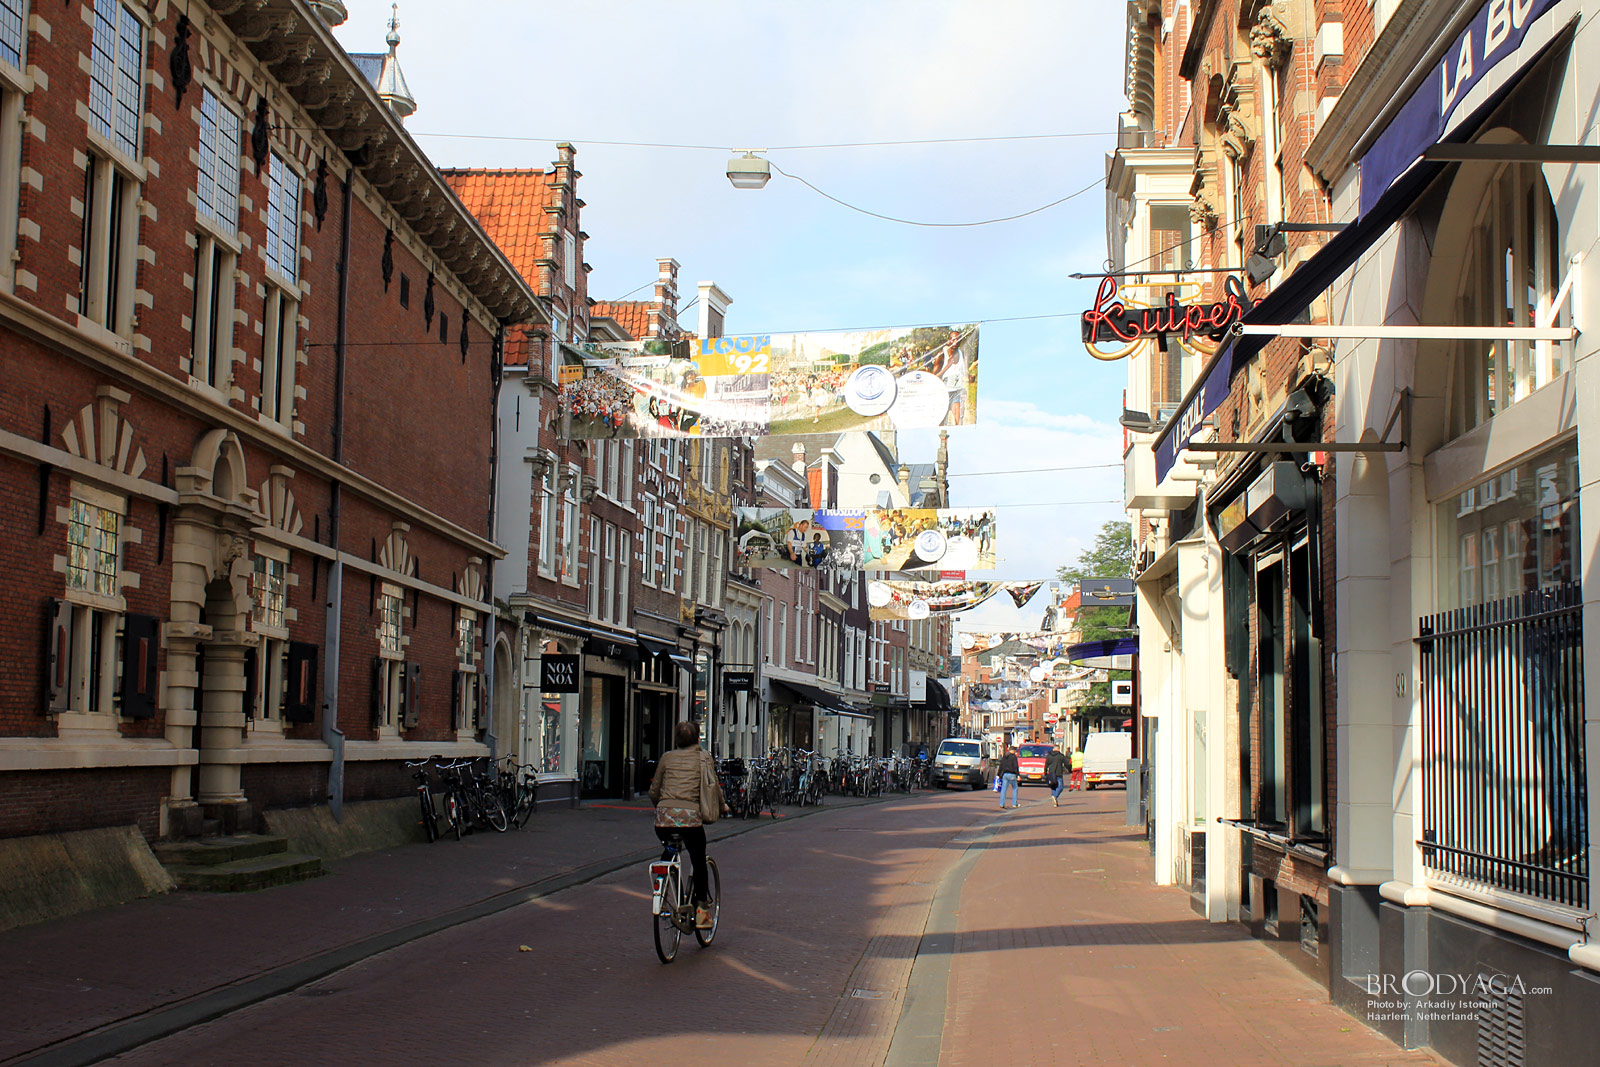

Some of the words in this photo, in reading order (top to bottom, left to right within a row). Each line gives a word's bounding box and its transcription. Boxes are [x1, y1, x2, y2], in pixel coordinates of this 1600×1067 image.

[1441, 29, 1474, 117] LA
[1083, 276, 1264, 343] Kuiper
[701, 336, 771, 356] LOOP
[729, 354, 769, 373] '92
[843, 517, 865, 529] '95
[546, 662, 573, 674] NOA
[546, 674, 573, 685] NOA
